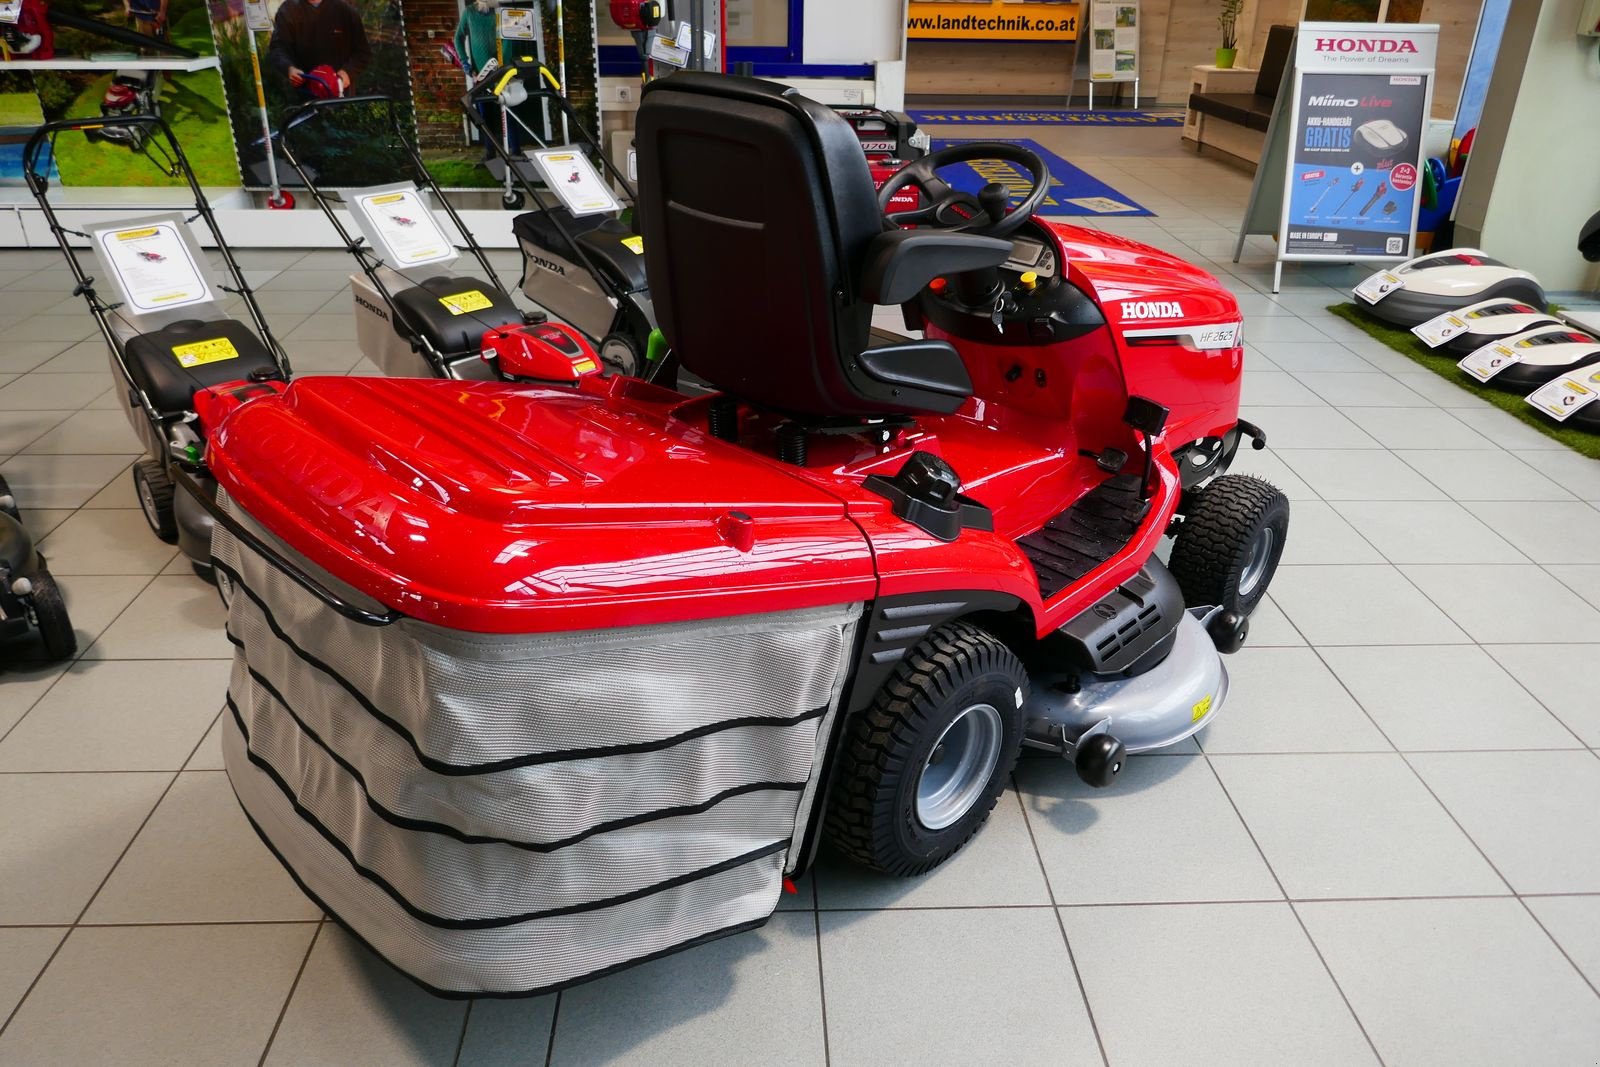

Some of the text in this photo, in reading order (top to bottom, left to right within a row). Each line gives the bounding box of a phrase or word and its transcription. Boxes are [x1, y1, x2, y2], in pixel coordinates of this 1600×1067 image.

[907, 14, 1075, 32] ww.landtechnik.co.at
[1314, 38, 1418, 53] HONDA
[1340, 55, 1365, 63] Power
[1308, 95, 1393, 107] Miimo Live
[1304, 127, 1352, 148] GRATIS
[355, 294, 389, 322] HONDA
[1121, 302, 1184, 319] HONDA
